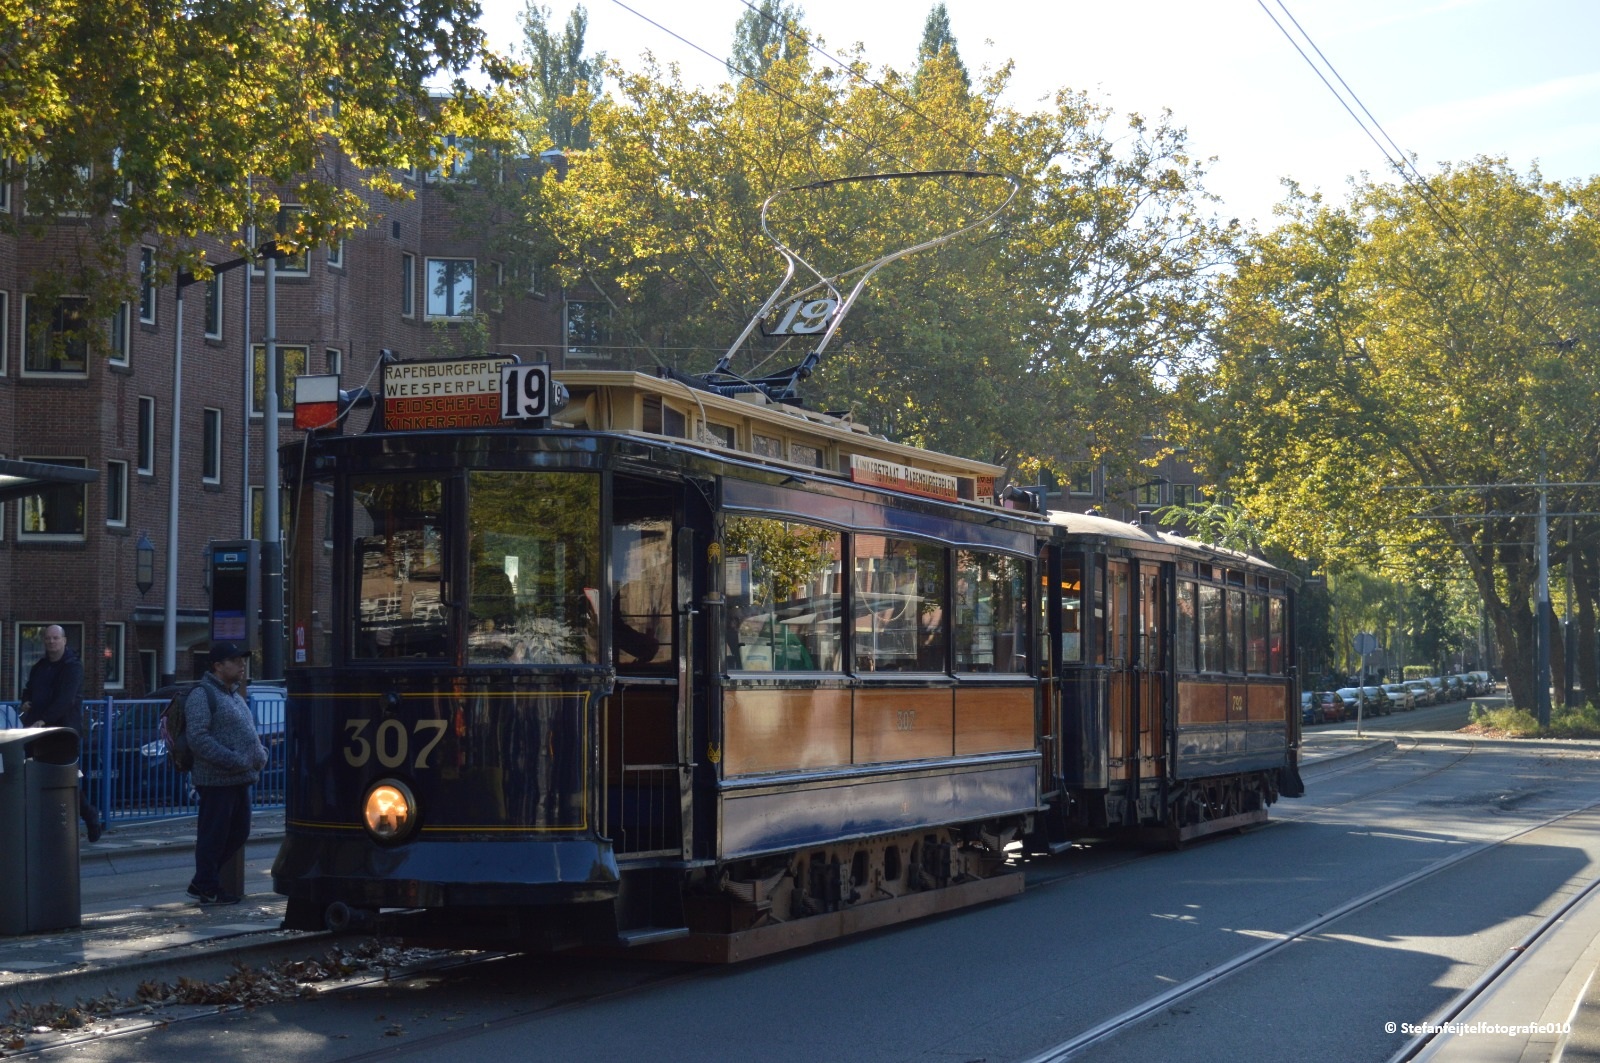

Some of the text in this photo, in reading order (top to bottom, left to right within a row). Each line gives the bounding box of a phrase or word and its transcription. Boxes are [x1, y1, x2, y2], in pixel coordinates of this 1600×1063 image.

[769, 299, 837, 335] 19
[386, 379, 499, 396] WEESPERPLE
[505, 368, 546, 416] 19
[553, 384, 562, 405] 19
[385, 396, 500, 414] LEIDSCHEPLE
[385, 412, 504, 430] KINKERSTRAA
[855, 456, 956, 497] KINKERSTRAAT RAPENBURGERPLEIN
[897, 710, 915, 731] 307
[343, 718, 448, 769] 307
